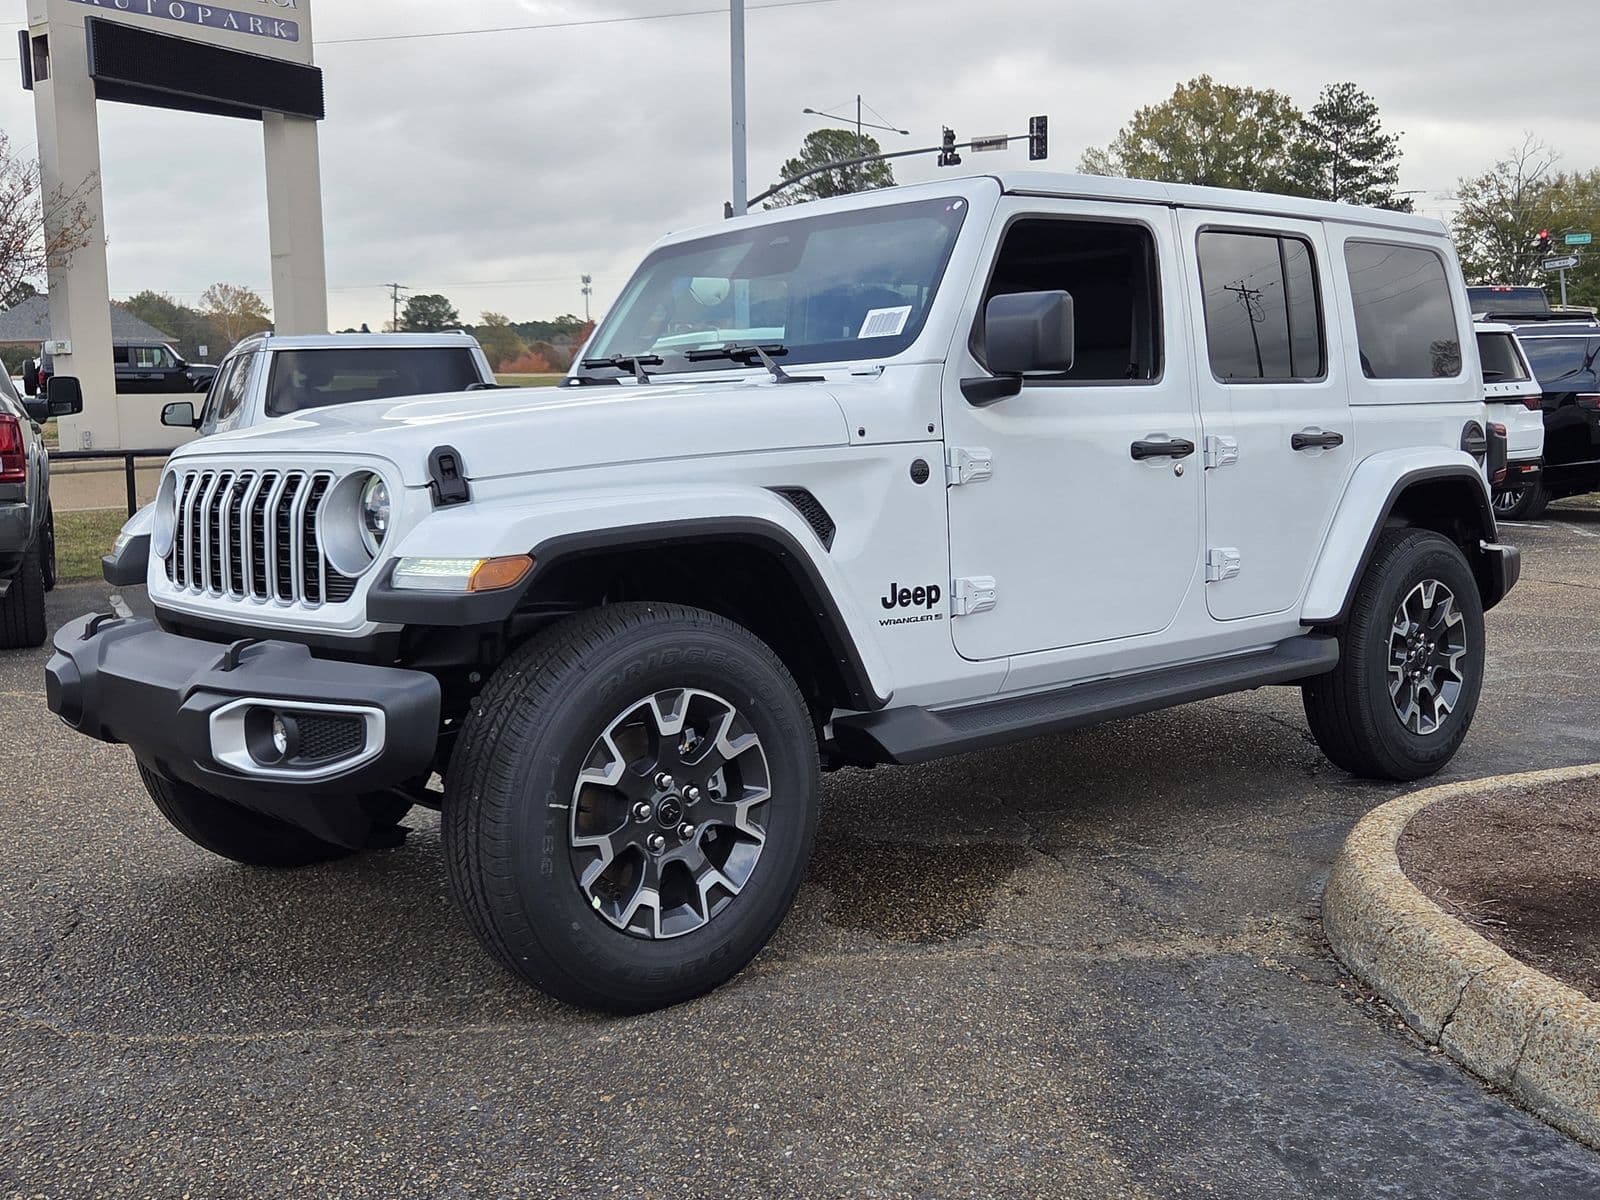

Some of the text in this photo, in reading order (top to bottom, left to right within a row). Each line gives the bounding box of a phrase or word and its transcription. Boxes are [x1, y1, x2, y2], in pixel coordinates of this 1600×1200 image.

[81, 0, 288, 39] UTOPARK
[881, 582, 941, 610] Jeep
[879, 614, 933, 626] WRANGLER
